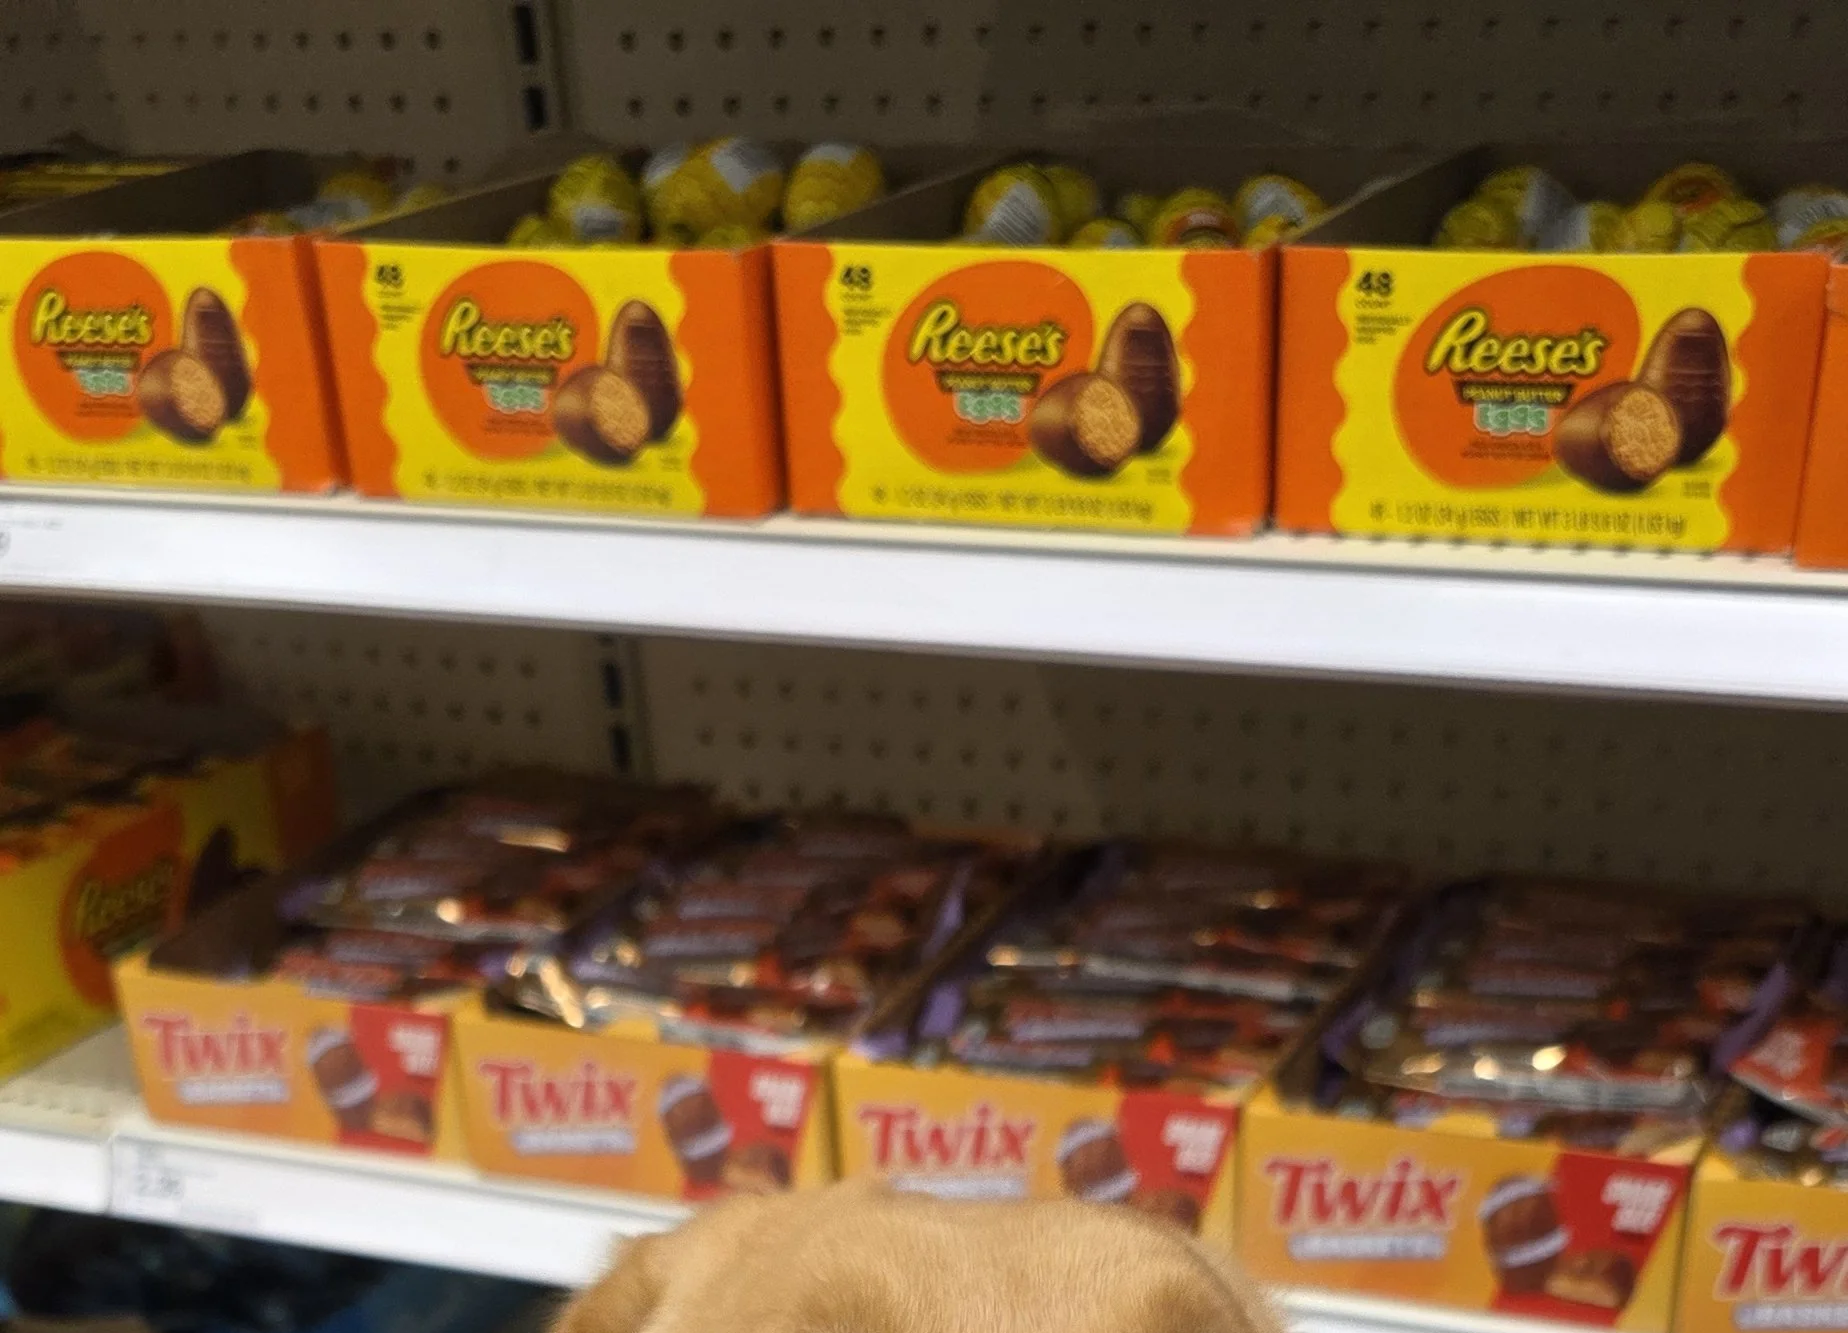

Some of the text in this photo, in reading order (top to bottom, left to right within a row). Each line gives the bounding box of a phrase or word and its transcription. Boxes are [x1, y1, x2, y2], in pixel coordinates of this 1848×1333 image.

[841, 265, 873, 291] 48
[1357, 271, 1394, 297] 48
[30, 289, 154, 346] Reese's
[440, 297, 576, 362] Reese's
[907, 301, 1066, 367] Reese's
[1424, 308, 1606, 377] Reese's
[142, 1012, 288, 1074] Twix
[480, 1061, 639, 1122] Twix
[857, 1103, 1036, 1168] Twix
[1264, 1157, 1461, 1227] Twix
[1714, 1223, 1848, 1295] Tw
